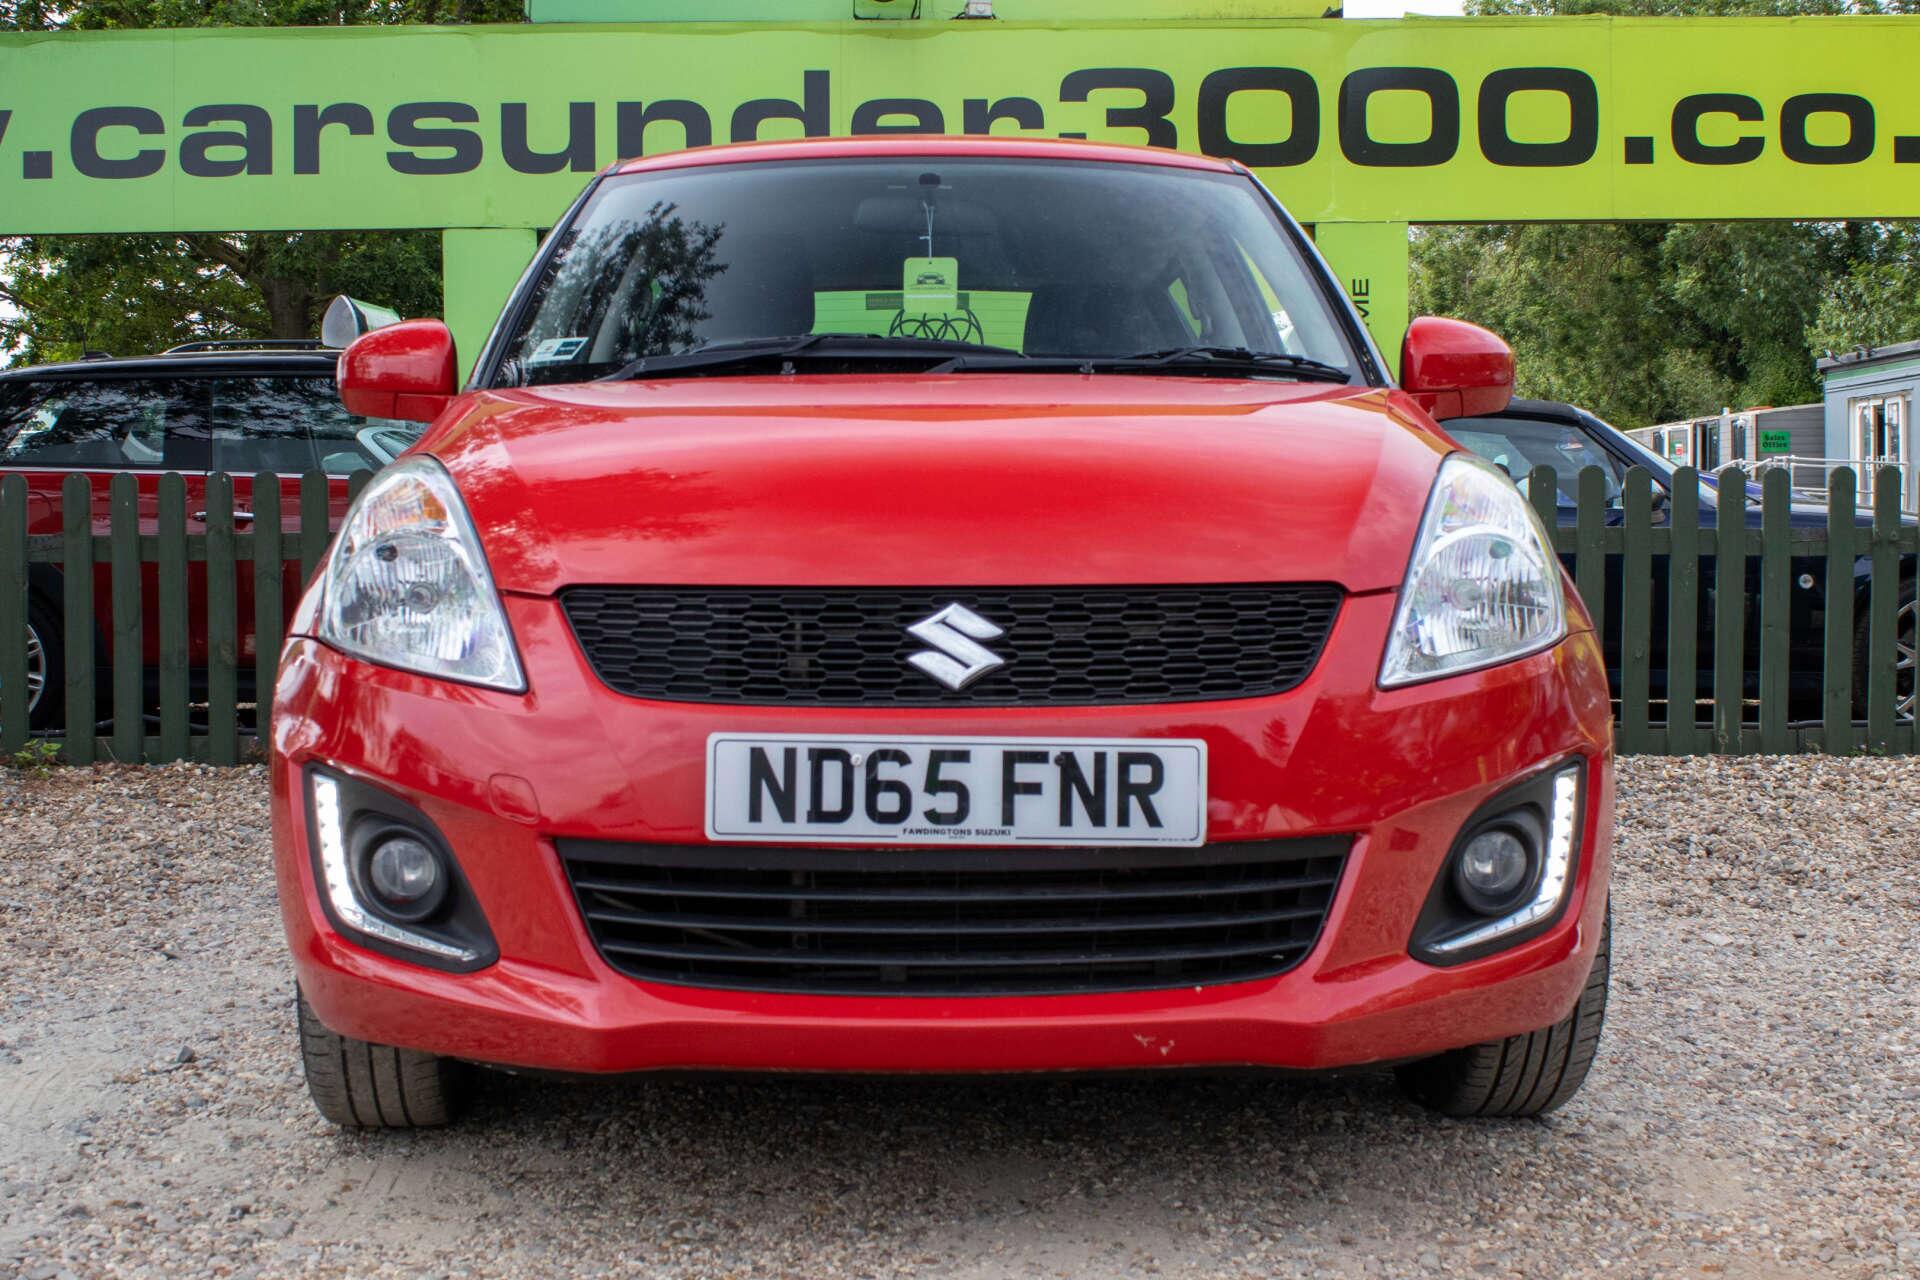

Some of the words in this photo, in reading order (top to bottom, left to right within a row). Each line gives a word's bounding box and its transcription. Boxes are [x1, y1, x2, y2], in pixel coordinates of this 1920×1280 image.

[0, 66, 1920, 179] .carsunder3000.co.
[748, 746, 971, 827] ND65
[1001, 749, 1165, 829] FNR
[902, 828, 972, 836] FAWDINGTONS
[975, 828, 1012, 837] SUZUKI
